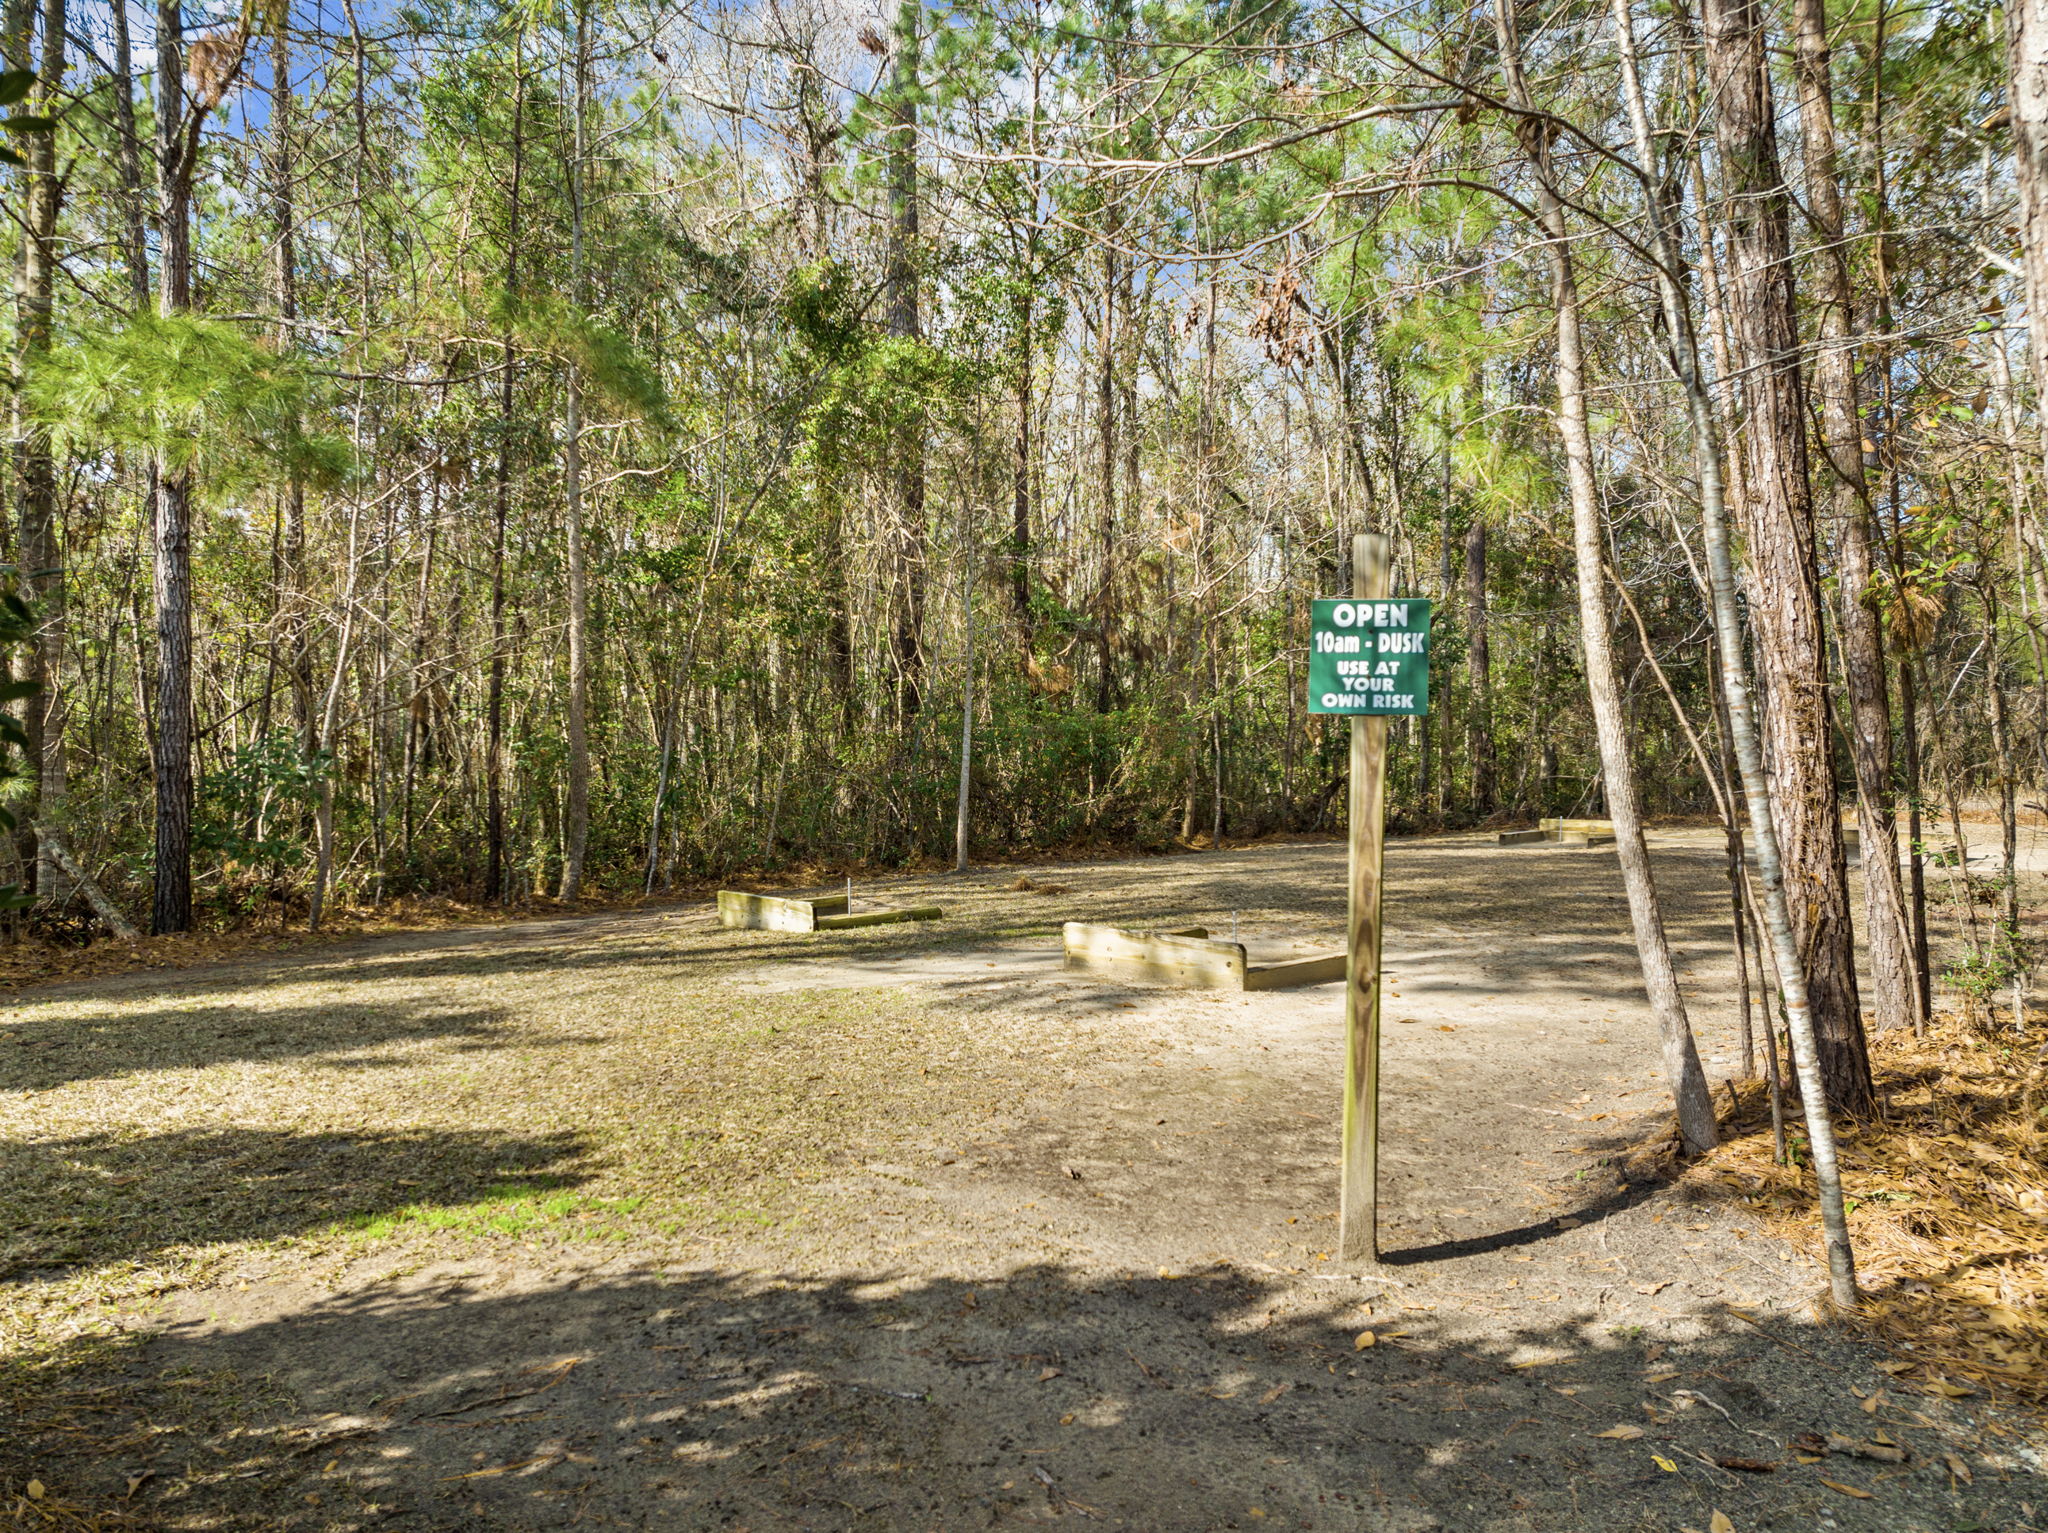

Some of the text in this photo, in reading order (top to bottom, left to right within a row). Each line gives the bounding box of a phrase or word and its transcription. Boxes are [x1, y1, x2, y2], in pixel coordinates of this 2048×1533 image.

[1333, 603, 1408, 627] OPEN
[1315, 631, 1360, 653] 10am
[1378, 632, 1424, 653] DUSK
[1336, 661, 1400, 675] USE AT
[1342, 677, 1394, 691] YOUR
[1321, 692, 1414, 708] OWN RISK
